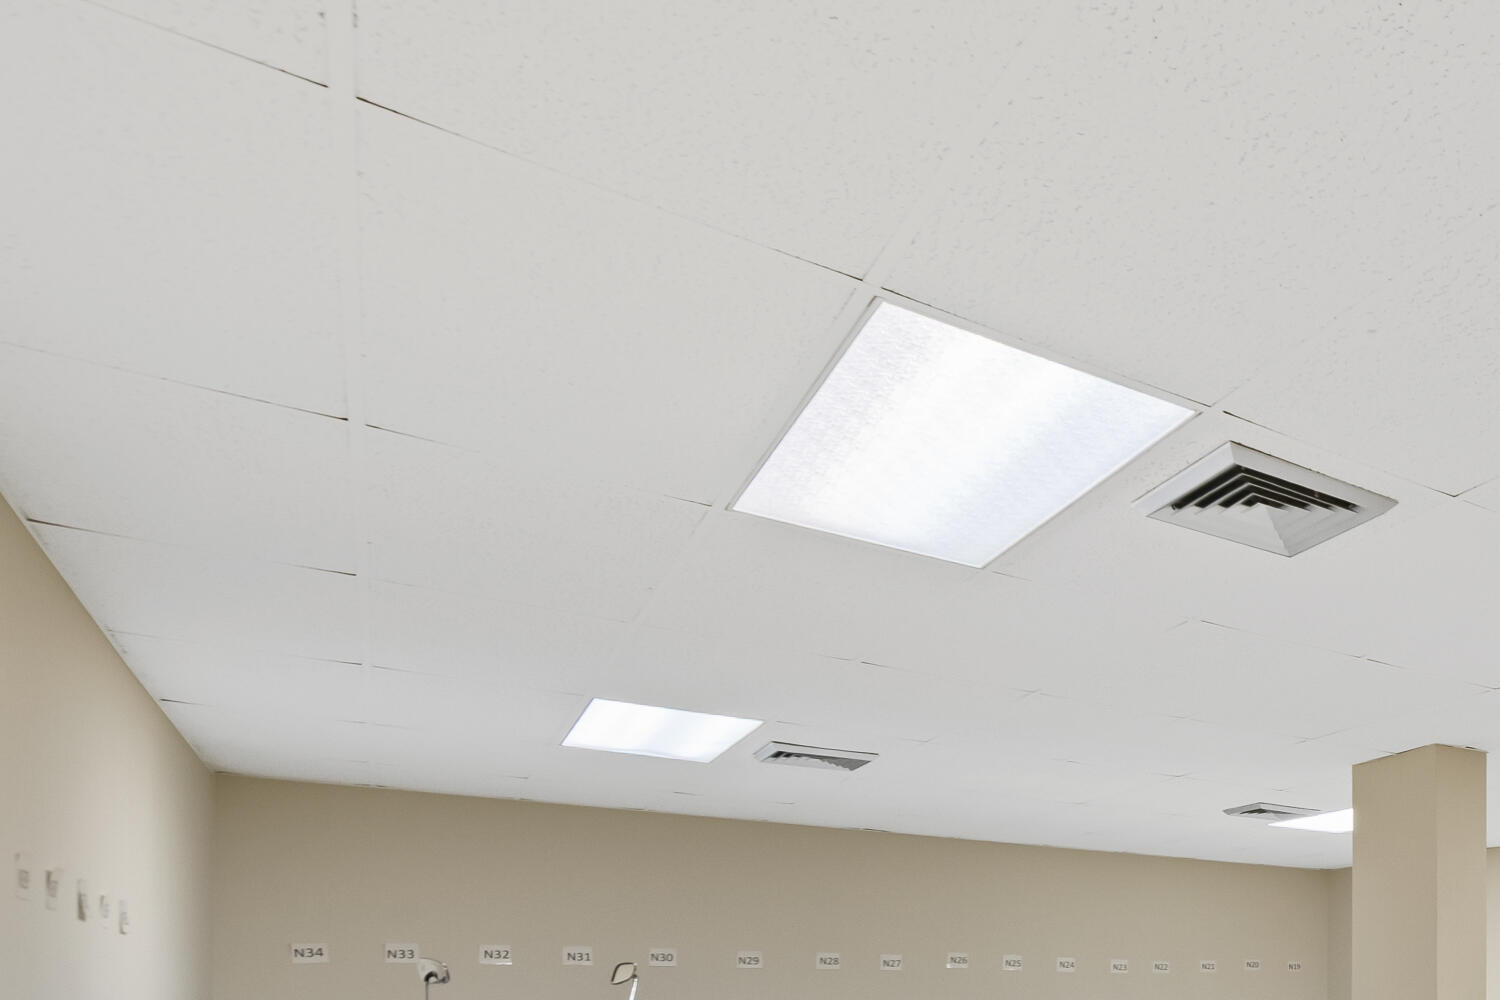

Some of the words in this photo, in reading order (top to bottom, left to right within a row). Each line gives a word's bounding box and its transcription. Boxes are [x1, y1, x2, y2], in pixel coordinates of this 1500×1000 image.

[293, 948, 324, 958] N34
[387, 949, 415, 959] N33
[483, 949, 510, 959] N32
[567, 952, 591, 962] N31
[650, 953, 674, 963] N30
[738, 956, 760, 966] N29
[819, 957, 839, 966] N28
[950, 957, 968, 965] N26
[883, 959, 901, 969] N27
[1005, 960, 1022, 968] N25
[1059, 961, 1075, 970] N24
[1113, 964, 1127, 972] N23
[1154, 963, 1168, 971] N22
[1202, 963, 1215, 971] N21
[1246, 961, 1259, 969] N20
